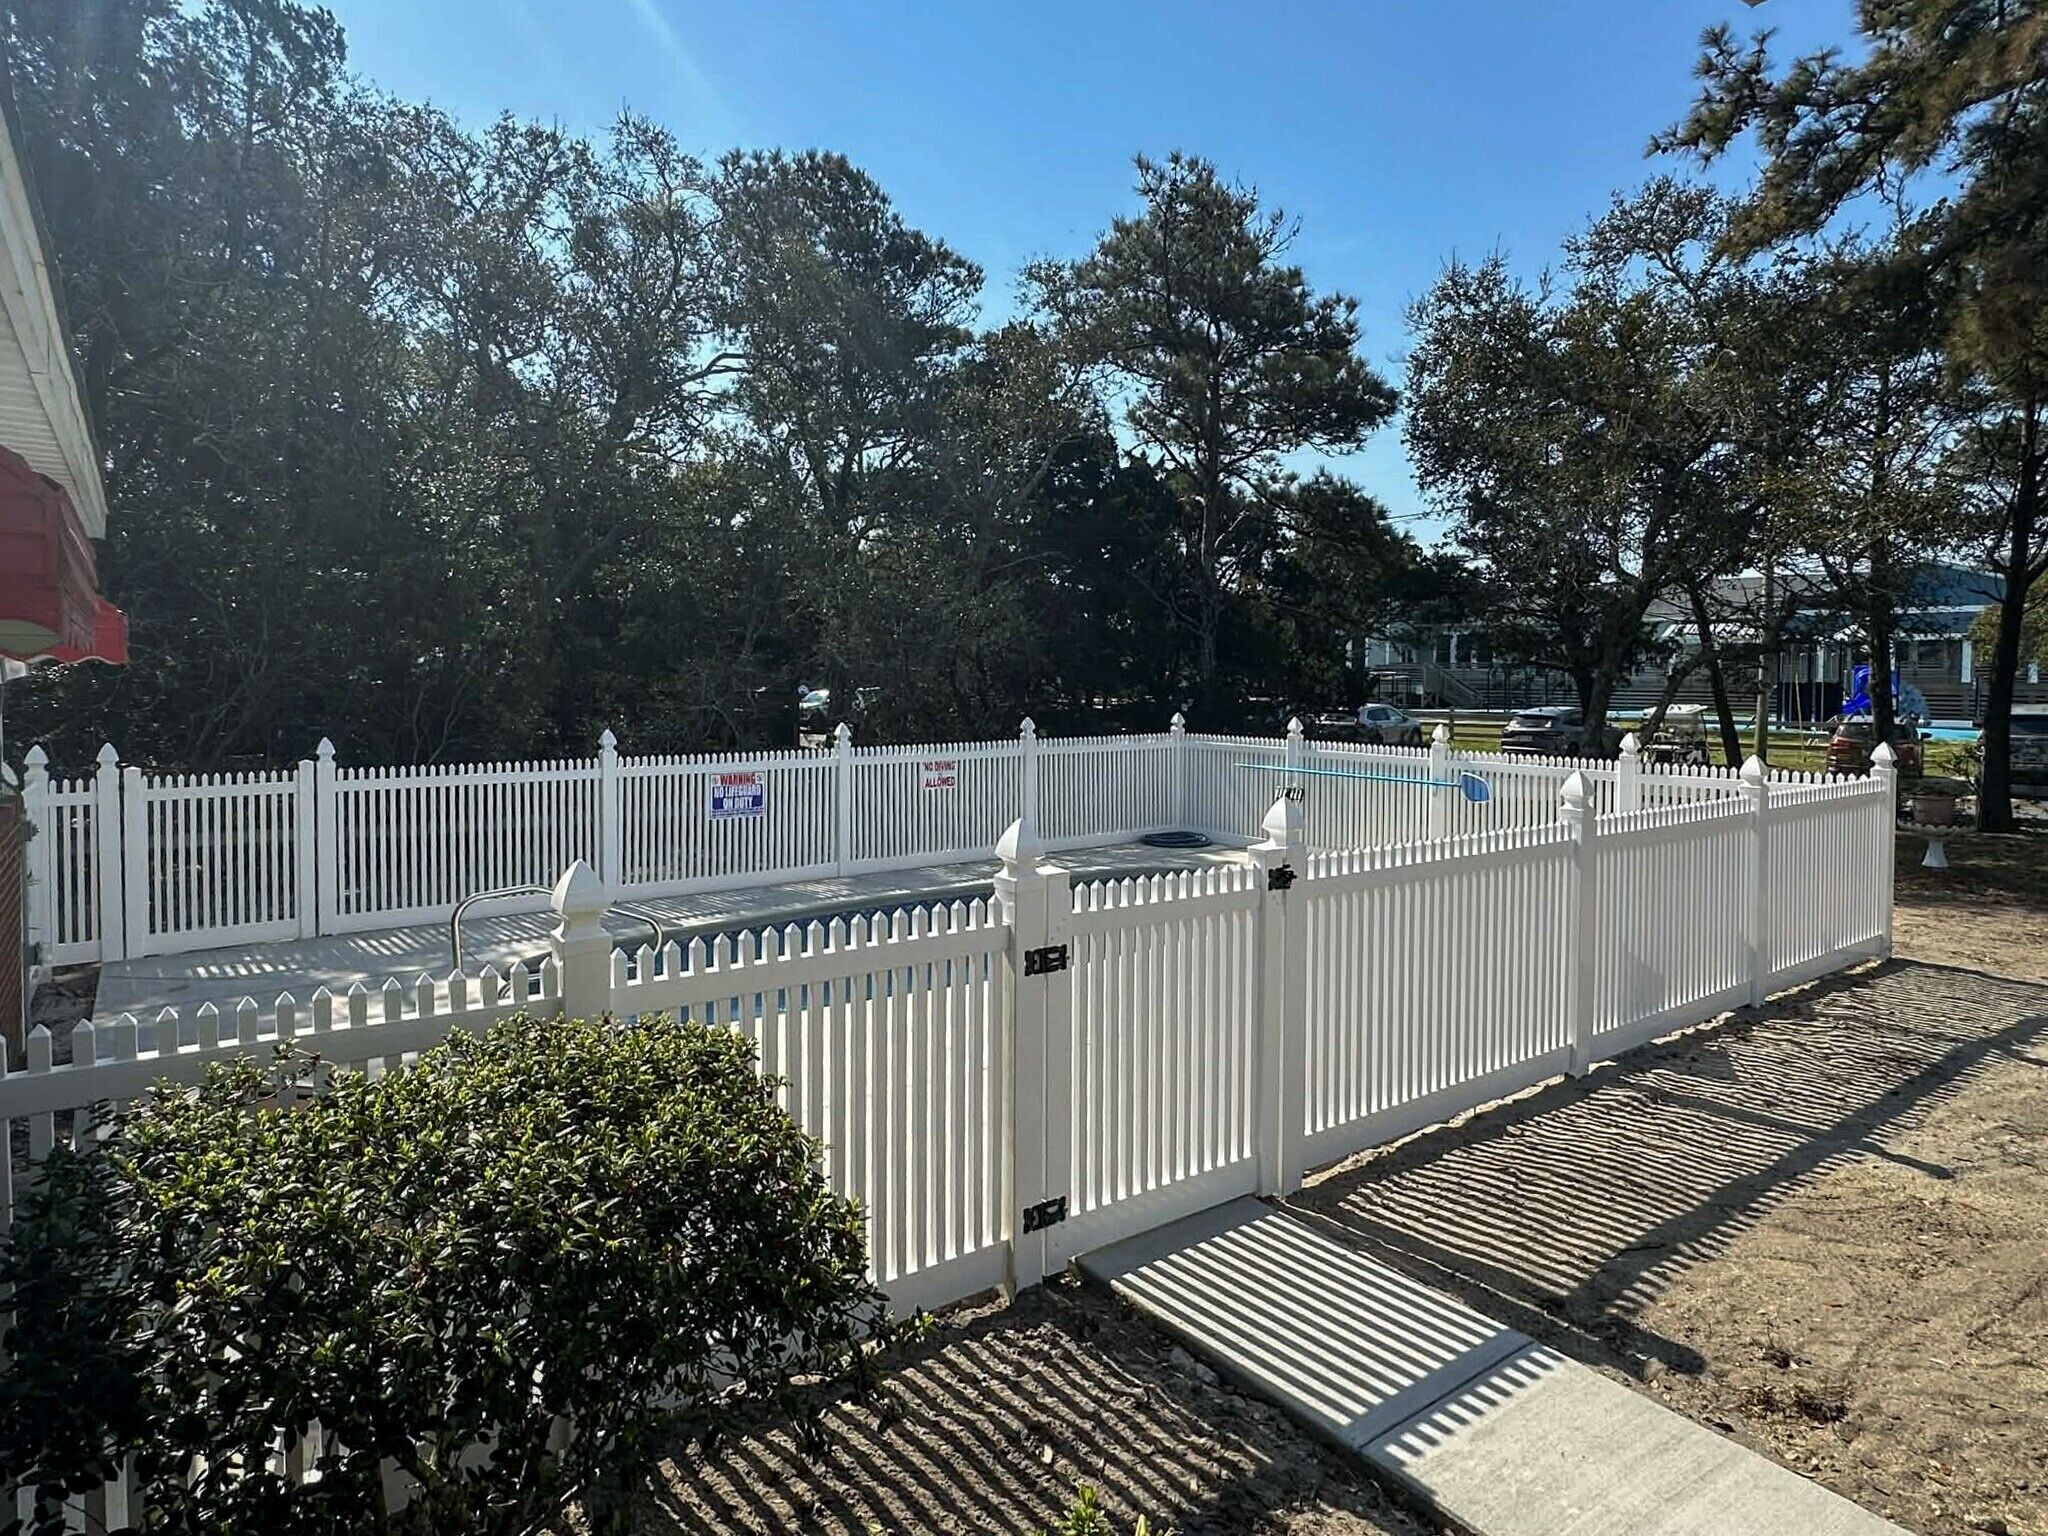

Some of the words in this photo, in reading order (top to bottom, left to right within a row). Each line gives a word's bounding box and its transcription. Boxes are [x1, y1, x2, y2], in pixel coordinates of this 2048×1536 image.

[924, 761, 933, 771] NO
[935, 760, 956, 771] DIVING
[720, 773, 756, 785] WARNING
[925, 777, 955, 787] ALLOWED
[714, 786, 724, 798] NO
[726, 785, 761, 796] LIFEGUARD
[723, 798, 733, 810] ON
[735, 797, 753, 809] DUTY
